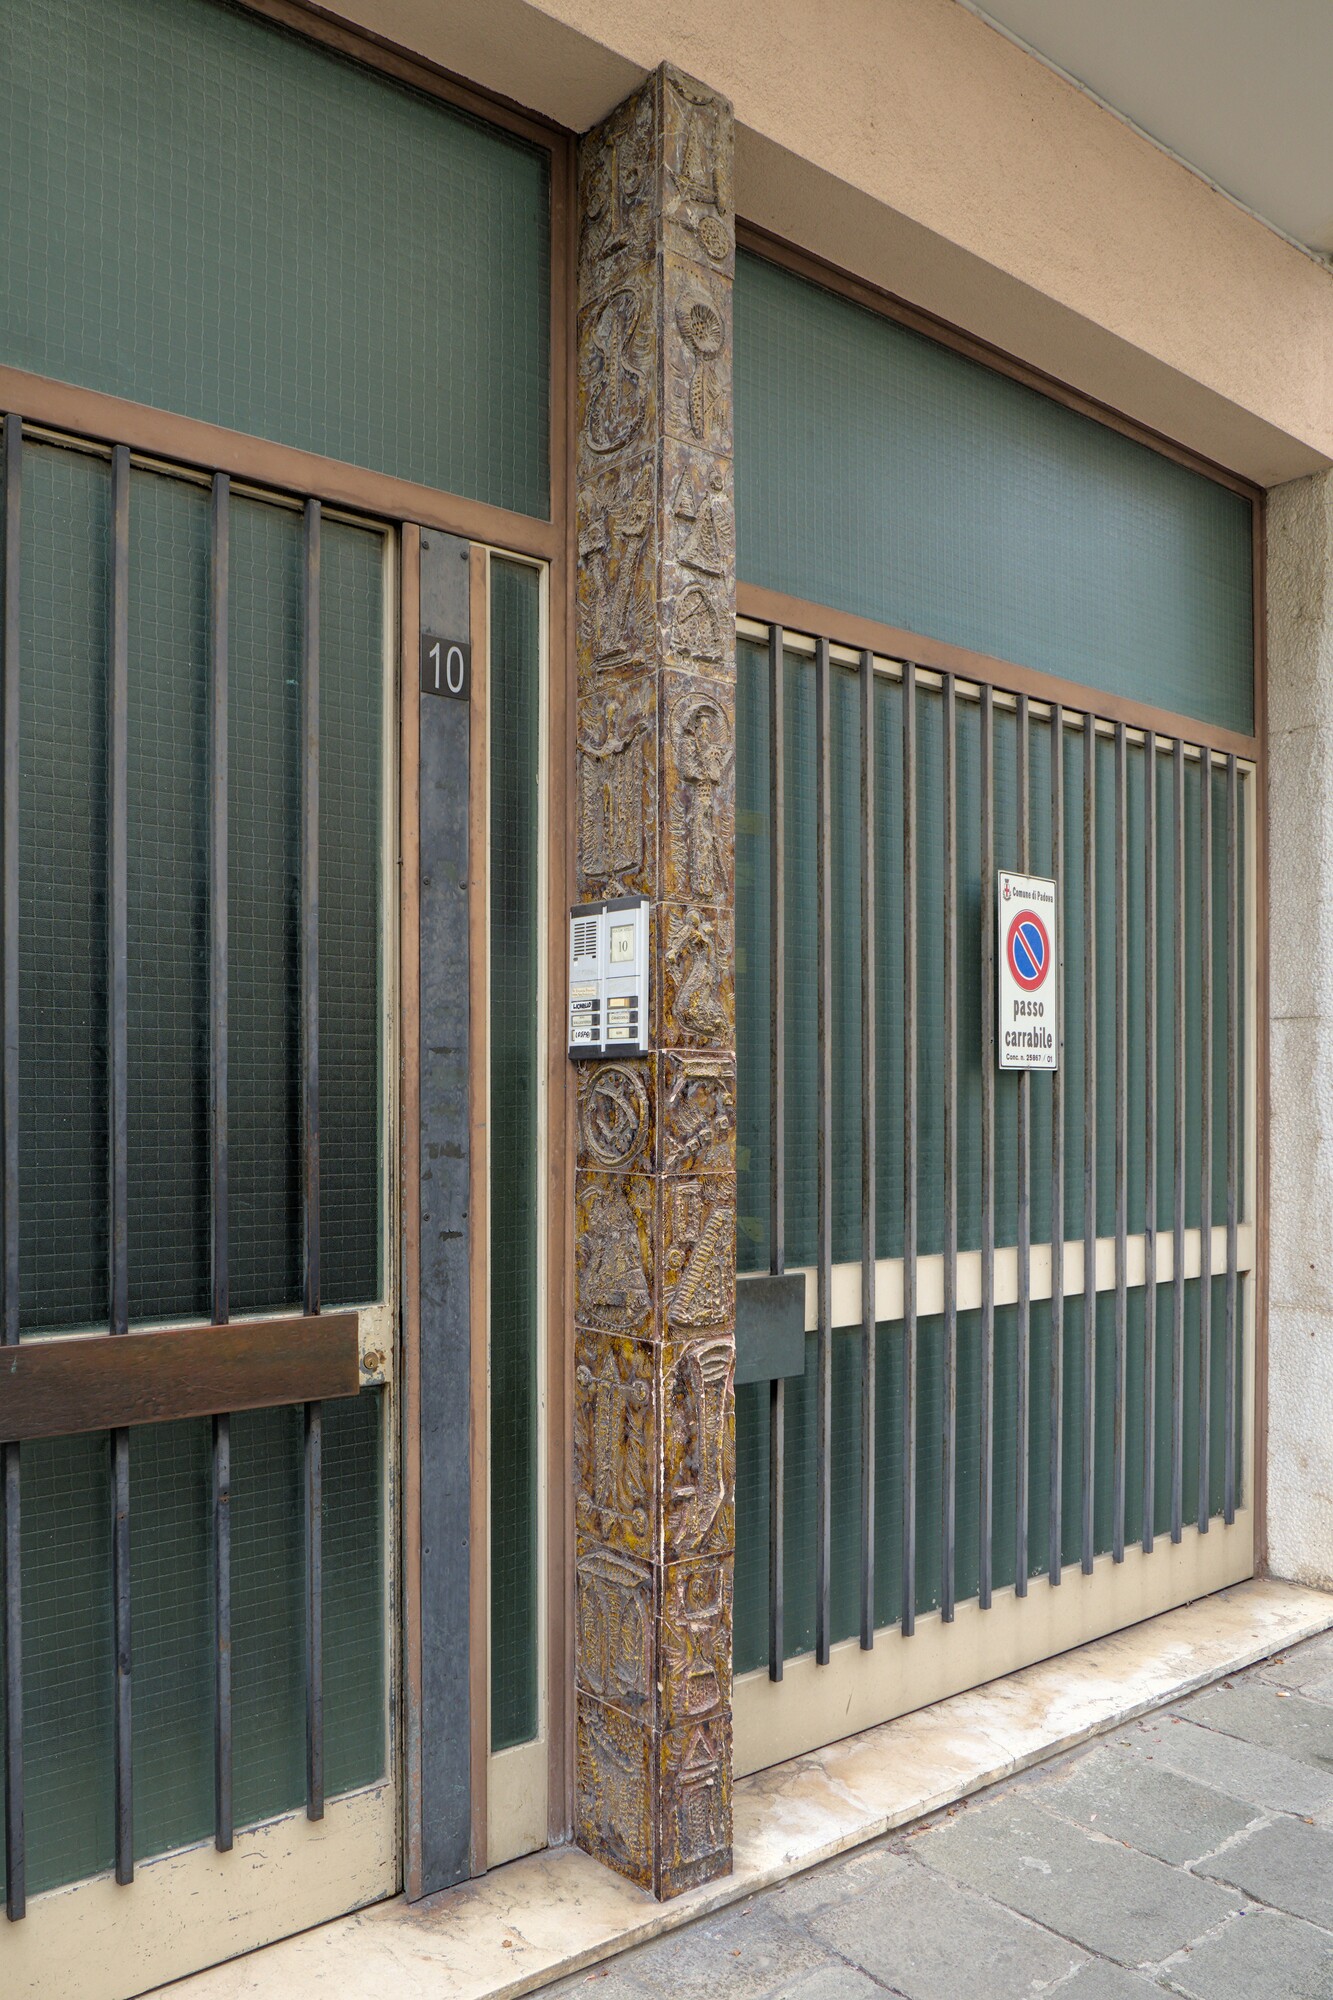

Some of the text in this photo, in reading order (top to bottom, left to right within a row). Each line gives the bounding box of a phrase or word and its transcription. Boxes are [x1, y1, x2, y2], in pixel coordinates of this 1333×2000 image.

[429, 642, 464, 693] 10
[1012, 886, 1053, 903] Comune di Padova
[619, 940, 628, 953] 10
[1013, 999, 1044, 1022] passo
[1005, 1026, 1053, 1049] carrabile
